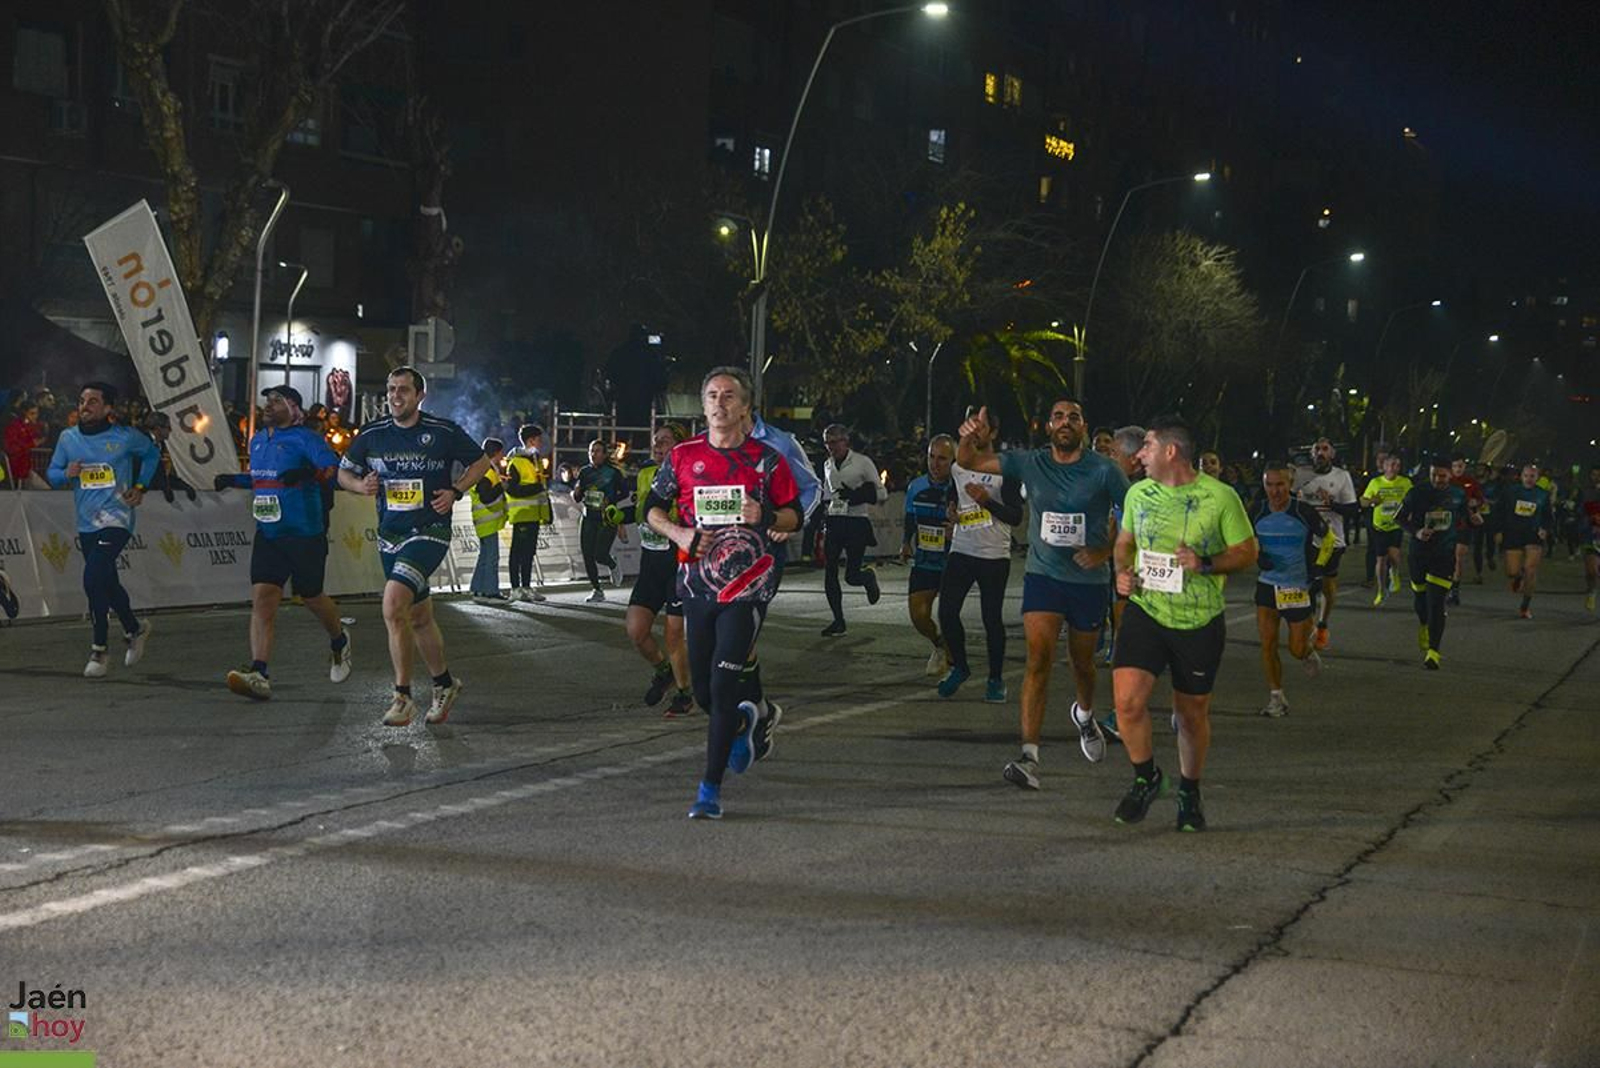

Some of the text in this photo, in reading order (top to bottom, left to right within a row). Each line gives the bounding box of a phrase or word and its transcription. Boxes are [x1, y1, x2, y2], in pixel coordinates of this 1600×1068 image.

[186, 530, 251, 548] CAJA RURAL
[1146, 566, 1173, 578] 7597
